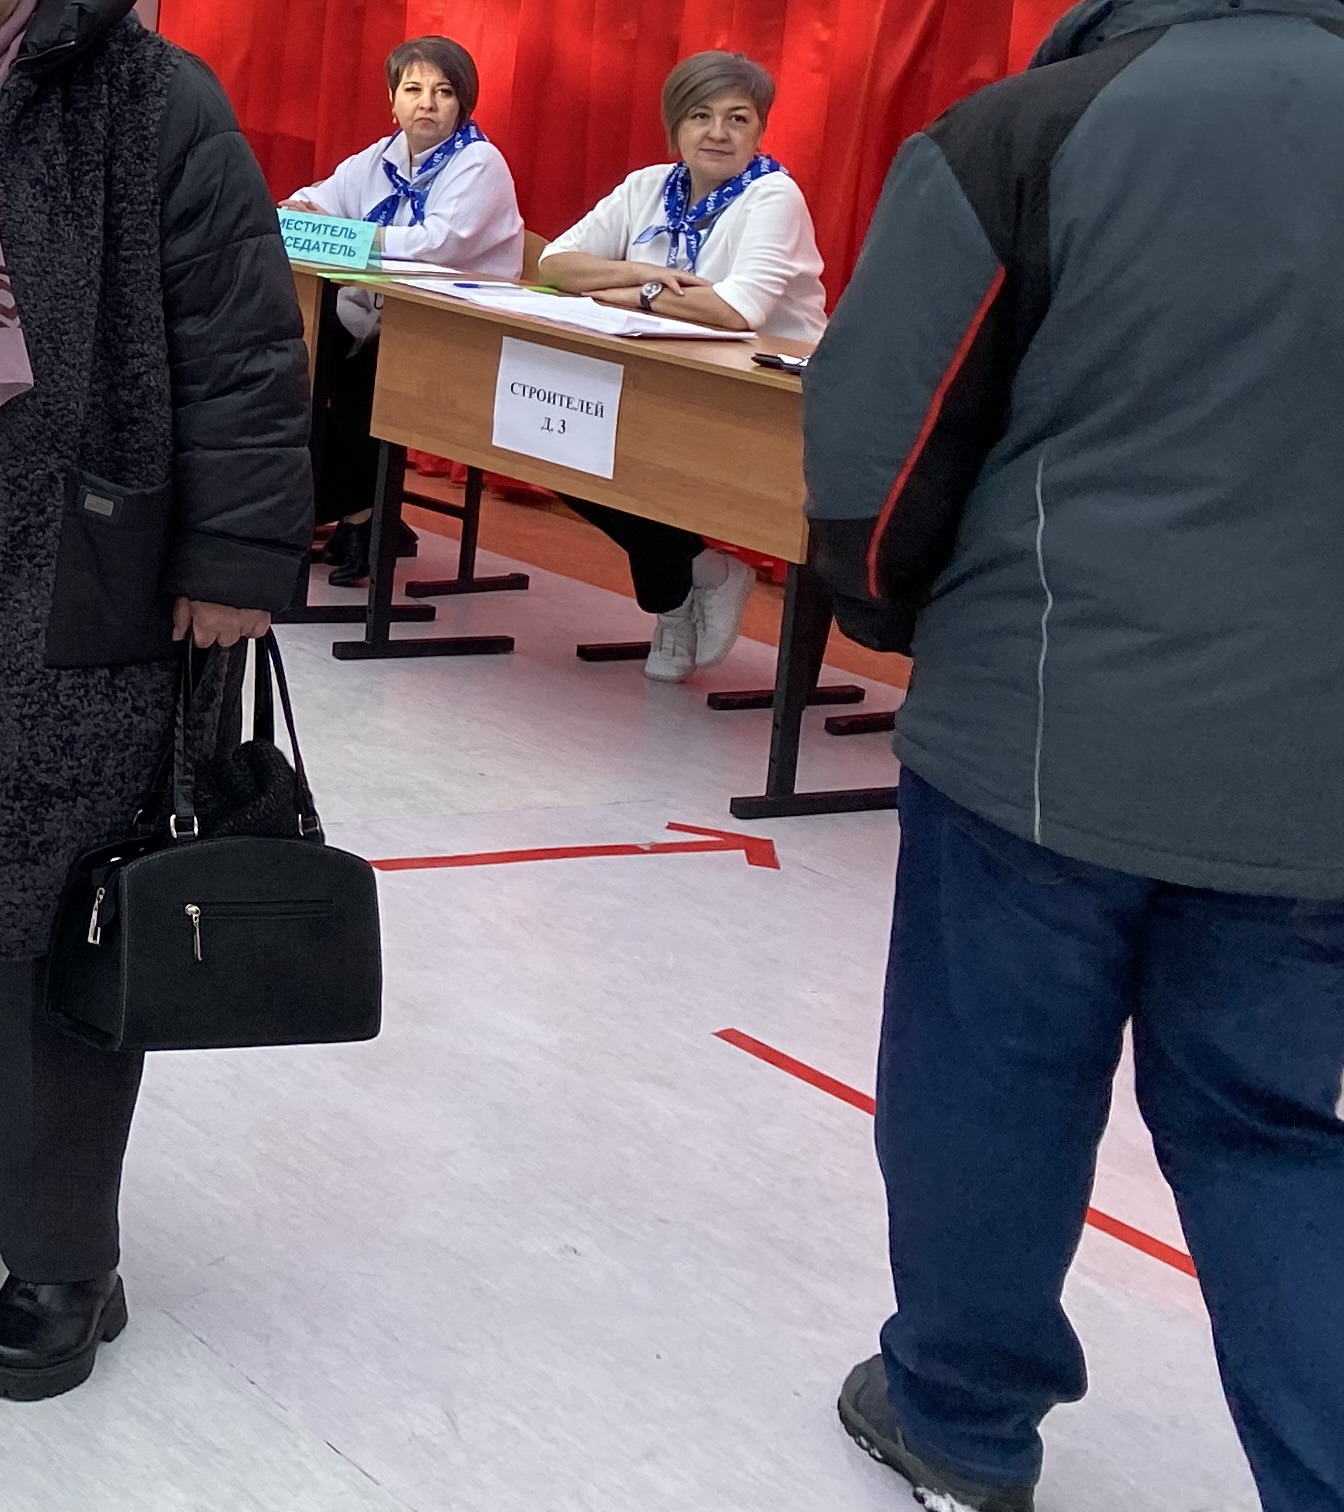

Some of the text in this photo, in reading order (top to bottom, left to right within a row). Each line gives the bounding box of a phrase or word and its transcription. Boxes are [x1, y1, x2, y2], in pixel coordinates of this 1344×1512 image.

[282, 236, 357, 258] СЕДАТЕЛЬ
[510, 381, 605, 419] СТРОИТЕЛЕЙ
[557, 419, 567, 435] 3
